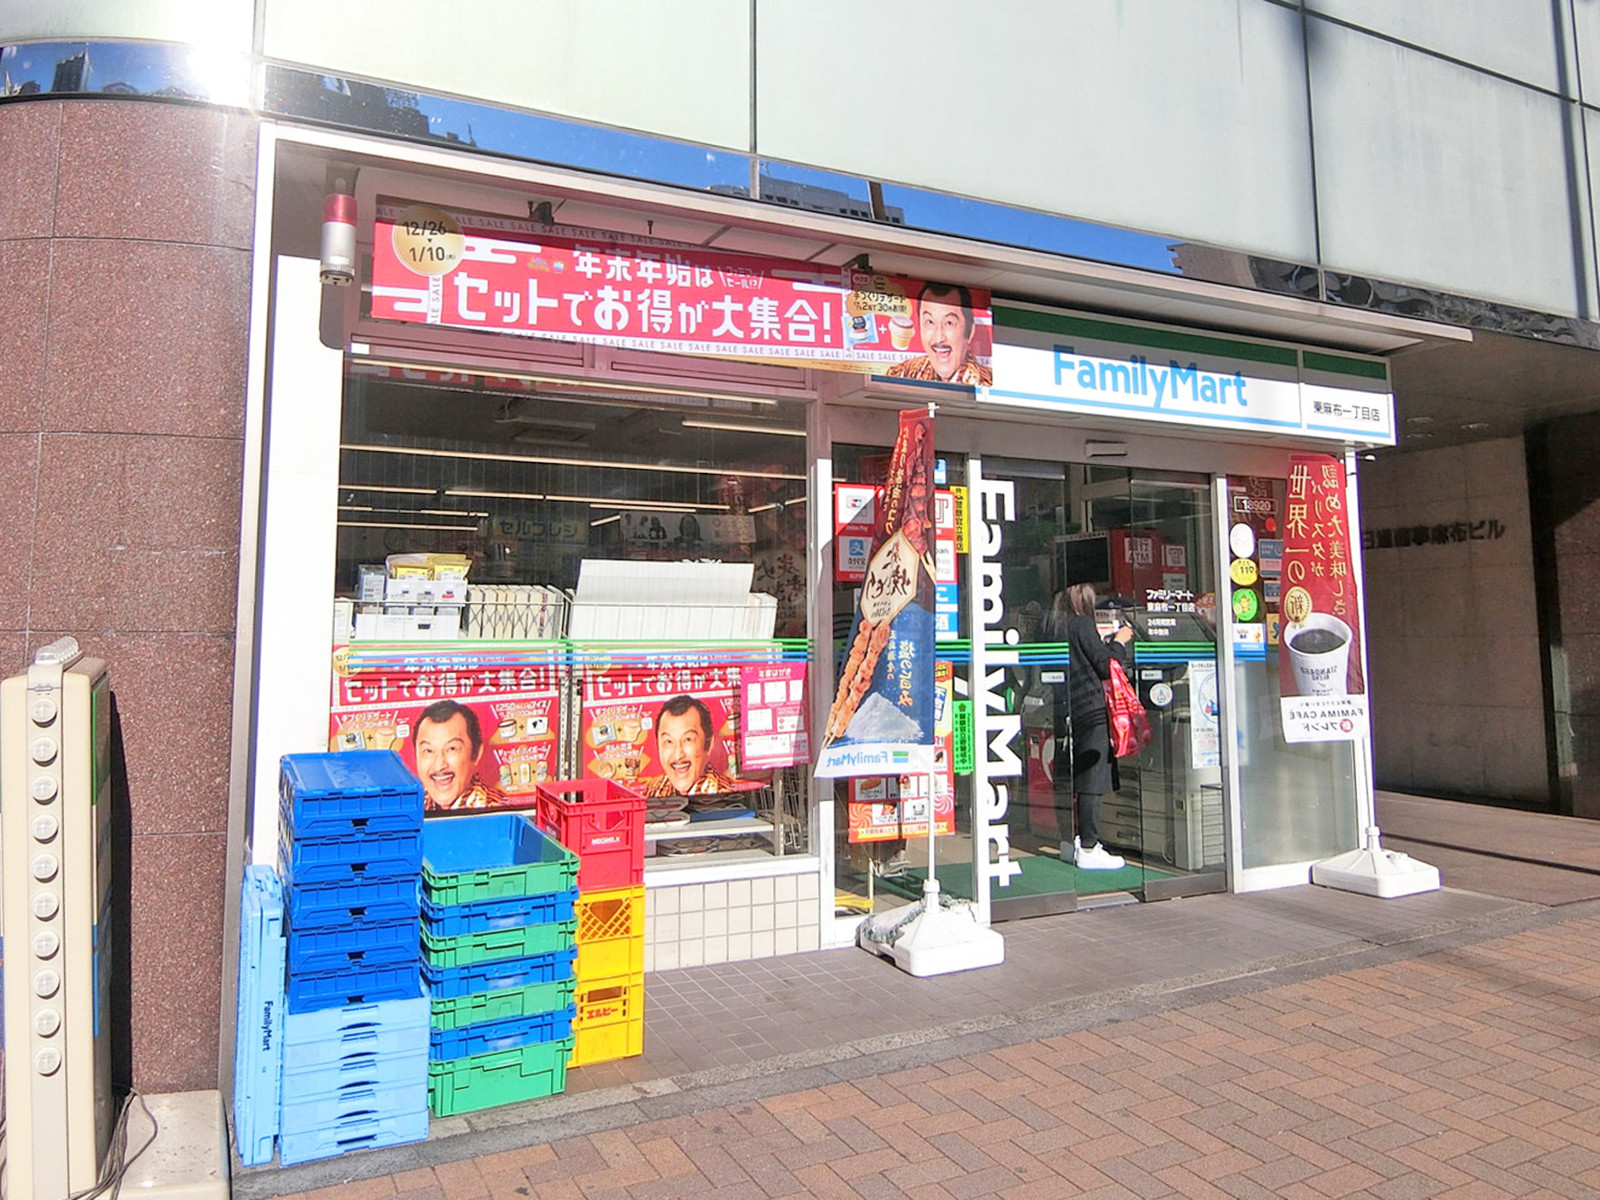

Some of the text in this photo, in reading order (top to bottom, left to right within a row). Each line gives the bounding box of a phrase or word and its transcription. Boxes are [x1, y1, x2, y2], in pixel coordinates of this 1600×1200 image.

[402, 220, 447, 236] 12/26
[480, 218, 505, 230] SALE
[510, 221, 536, 233] SALE
[541, 225, 567, 237] SALE
[571, 228, 597, 240] SALE
[601, 232, 625, 243] SALE
[630, 235, 654, 246] SALE
[409, 246, 445, 262] 1/10
[573, 243, 714, 288] 年末年始は
[431, 276, 441, 302] SALE
[453, 271, 831, 343] セットでお得が大集合!
[572, 335, 597, 345] SALE
[602, 337, 627, 347] SALE
[632, 340, 655, 349] SALE
[660, 341, 683, 351] SALE
[688, 342, 711, 352] SALE
[716, 344, 738, 354] SALE
[742, 346, 765, 355] SALE
[769, 347, 790, 357] SALE
[794, 349, 815, 358] SALE
[819, 350, 840, 359] SALE
[856, 351, 875, 360] SALE
[878, 352, 896, 361] SALE
[1053, 344, 1248, 410] FamilyMart
[1313, 401, 1381, 422] 東麻布一丁目店
[1241, 499, 1271, 511] 18920
[1146, 589, 1194, 600] ファミリーマート
[345, 666, 545, 702] セットでお得が大集合!
[981, 479, 1024, 888] FamilyMart
[261, 1000, 274, 1052] FamilyMart
[586, 1007, 618, 1020] エルビー
